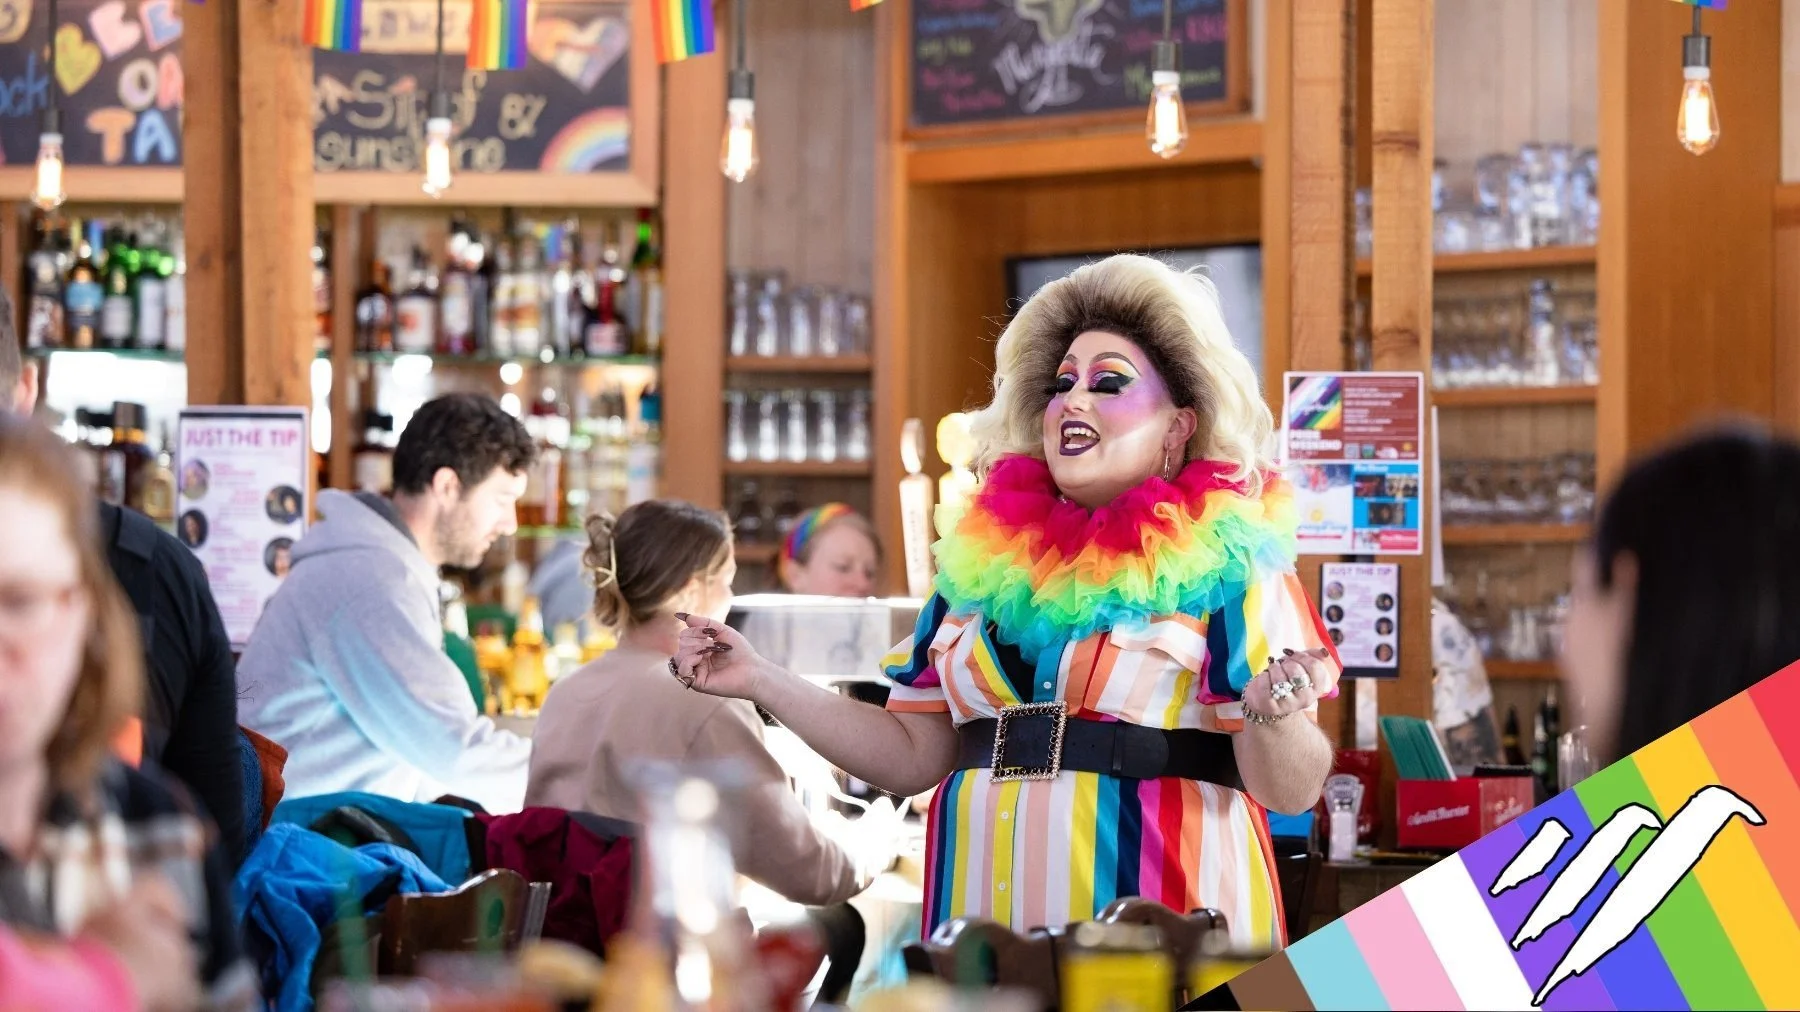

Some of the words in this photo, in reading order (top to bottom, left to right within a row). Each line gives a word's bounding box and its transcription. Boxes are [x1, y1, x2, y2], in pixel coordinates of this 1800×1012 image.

[315, 131, 506, 173] sunsne
[185, 427, 222, 448] JUST
[228, 427, 263, 448] THE
[269, 427, 298, 448] TIP
